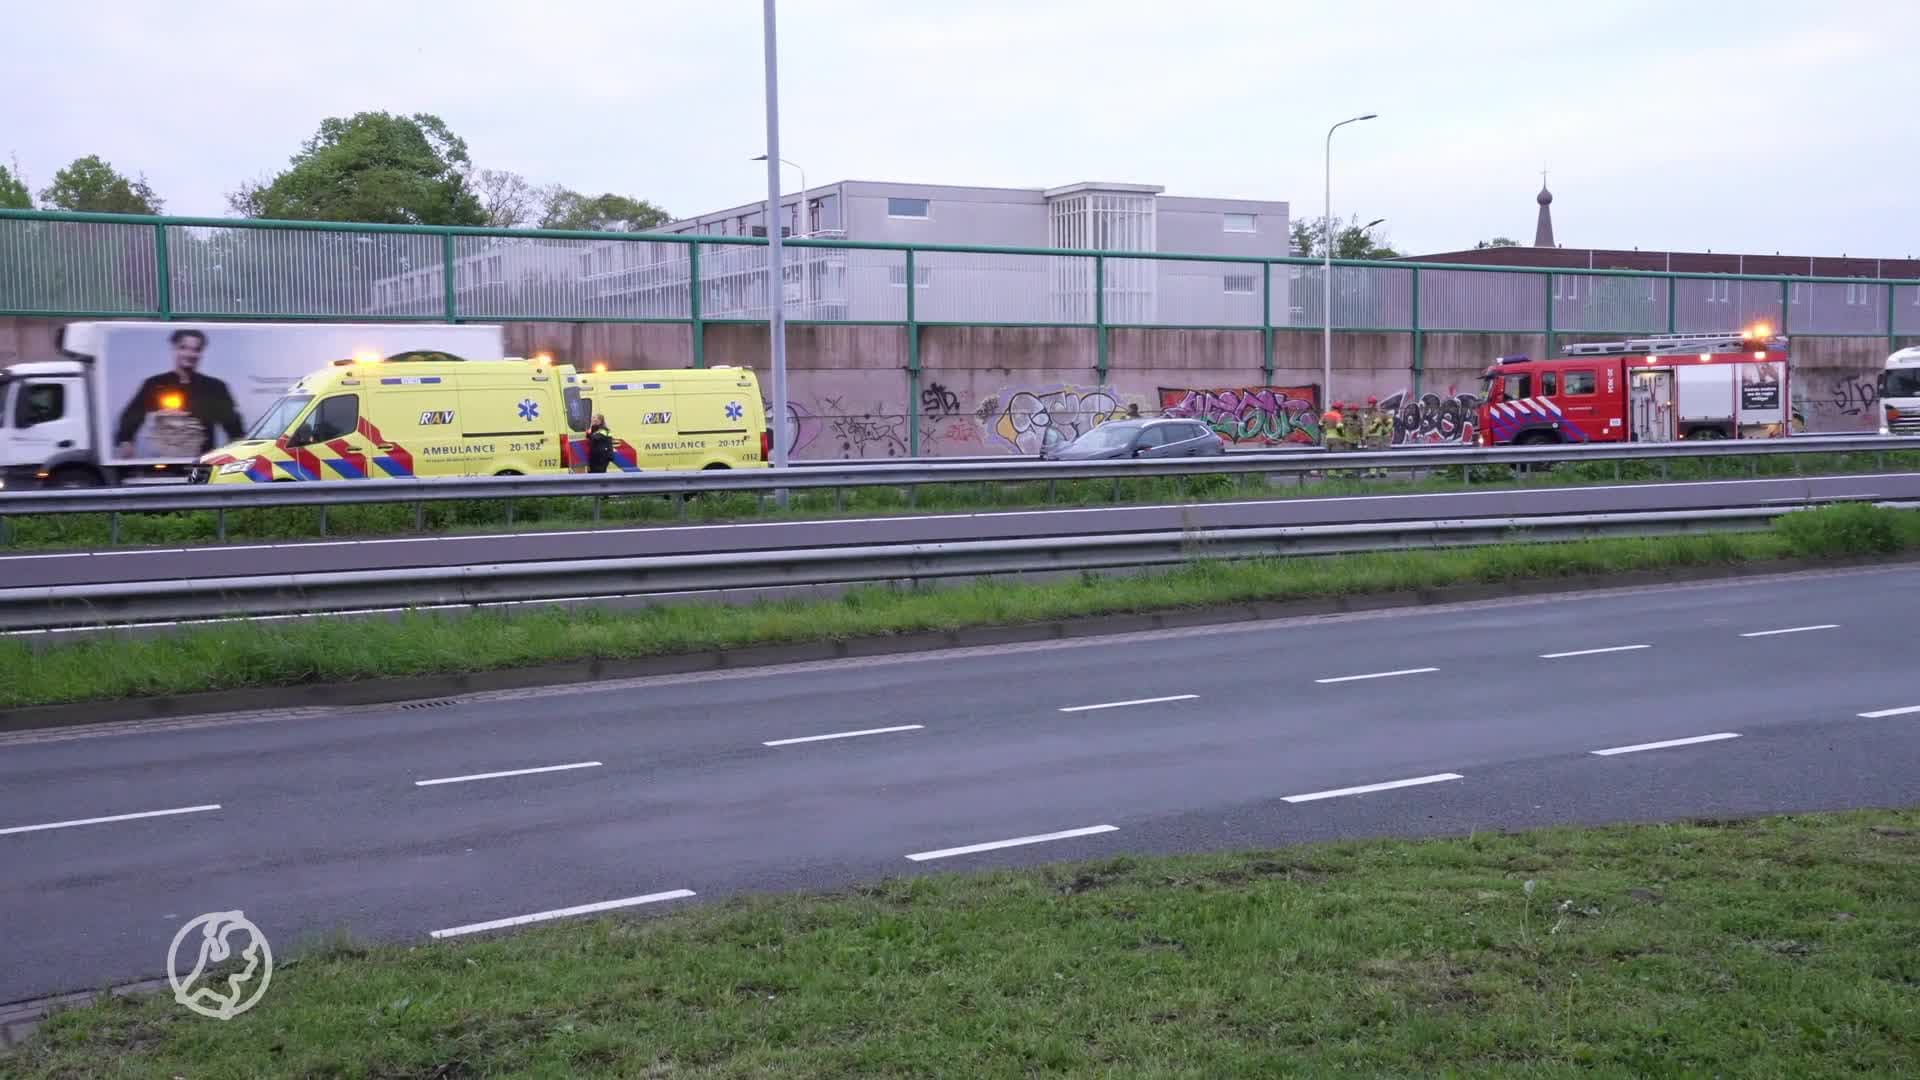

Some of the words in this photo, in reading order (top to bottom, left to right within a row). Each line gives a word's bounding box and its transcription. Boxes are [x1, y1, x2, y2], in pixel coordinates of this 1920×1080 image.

[420, 410, 455, 426] RAV
[642, 411, 672, 424] RAV
[509, 442, 541, 452] 20-182
[645, 440, 706, 450] AMBULANCE
[718, 439, 745, 447] 20-171
[423, 444, 496, 455] AMBULANCE
